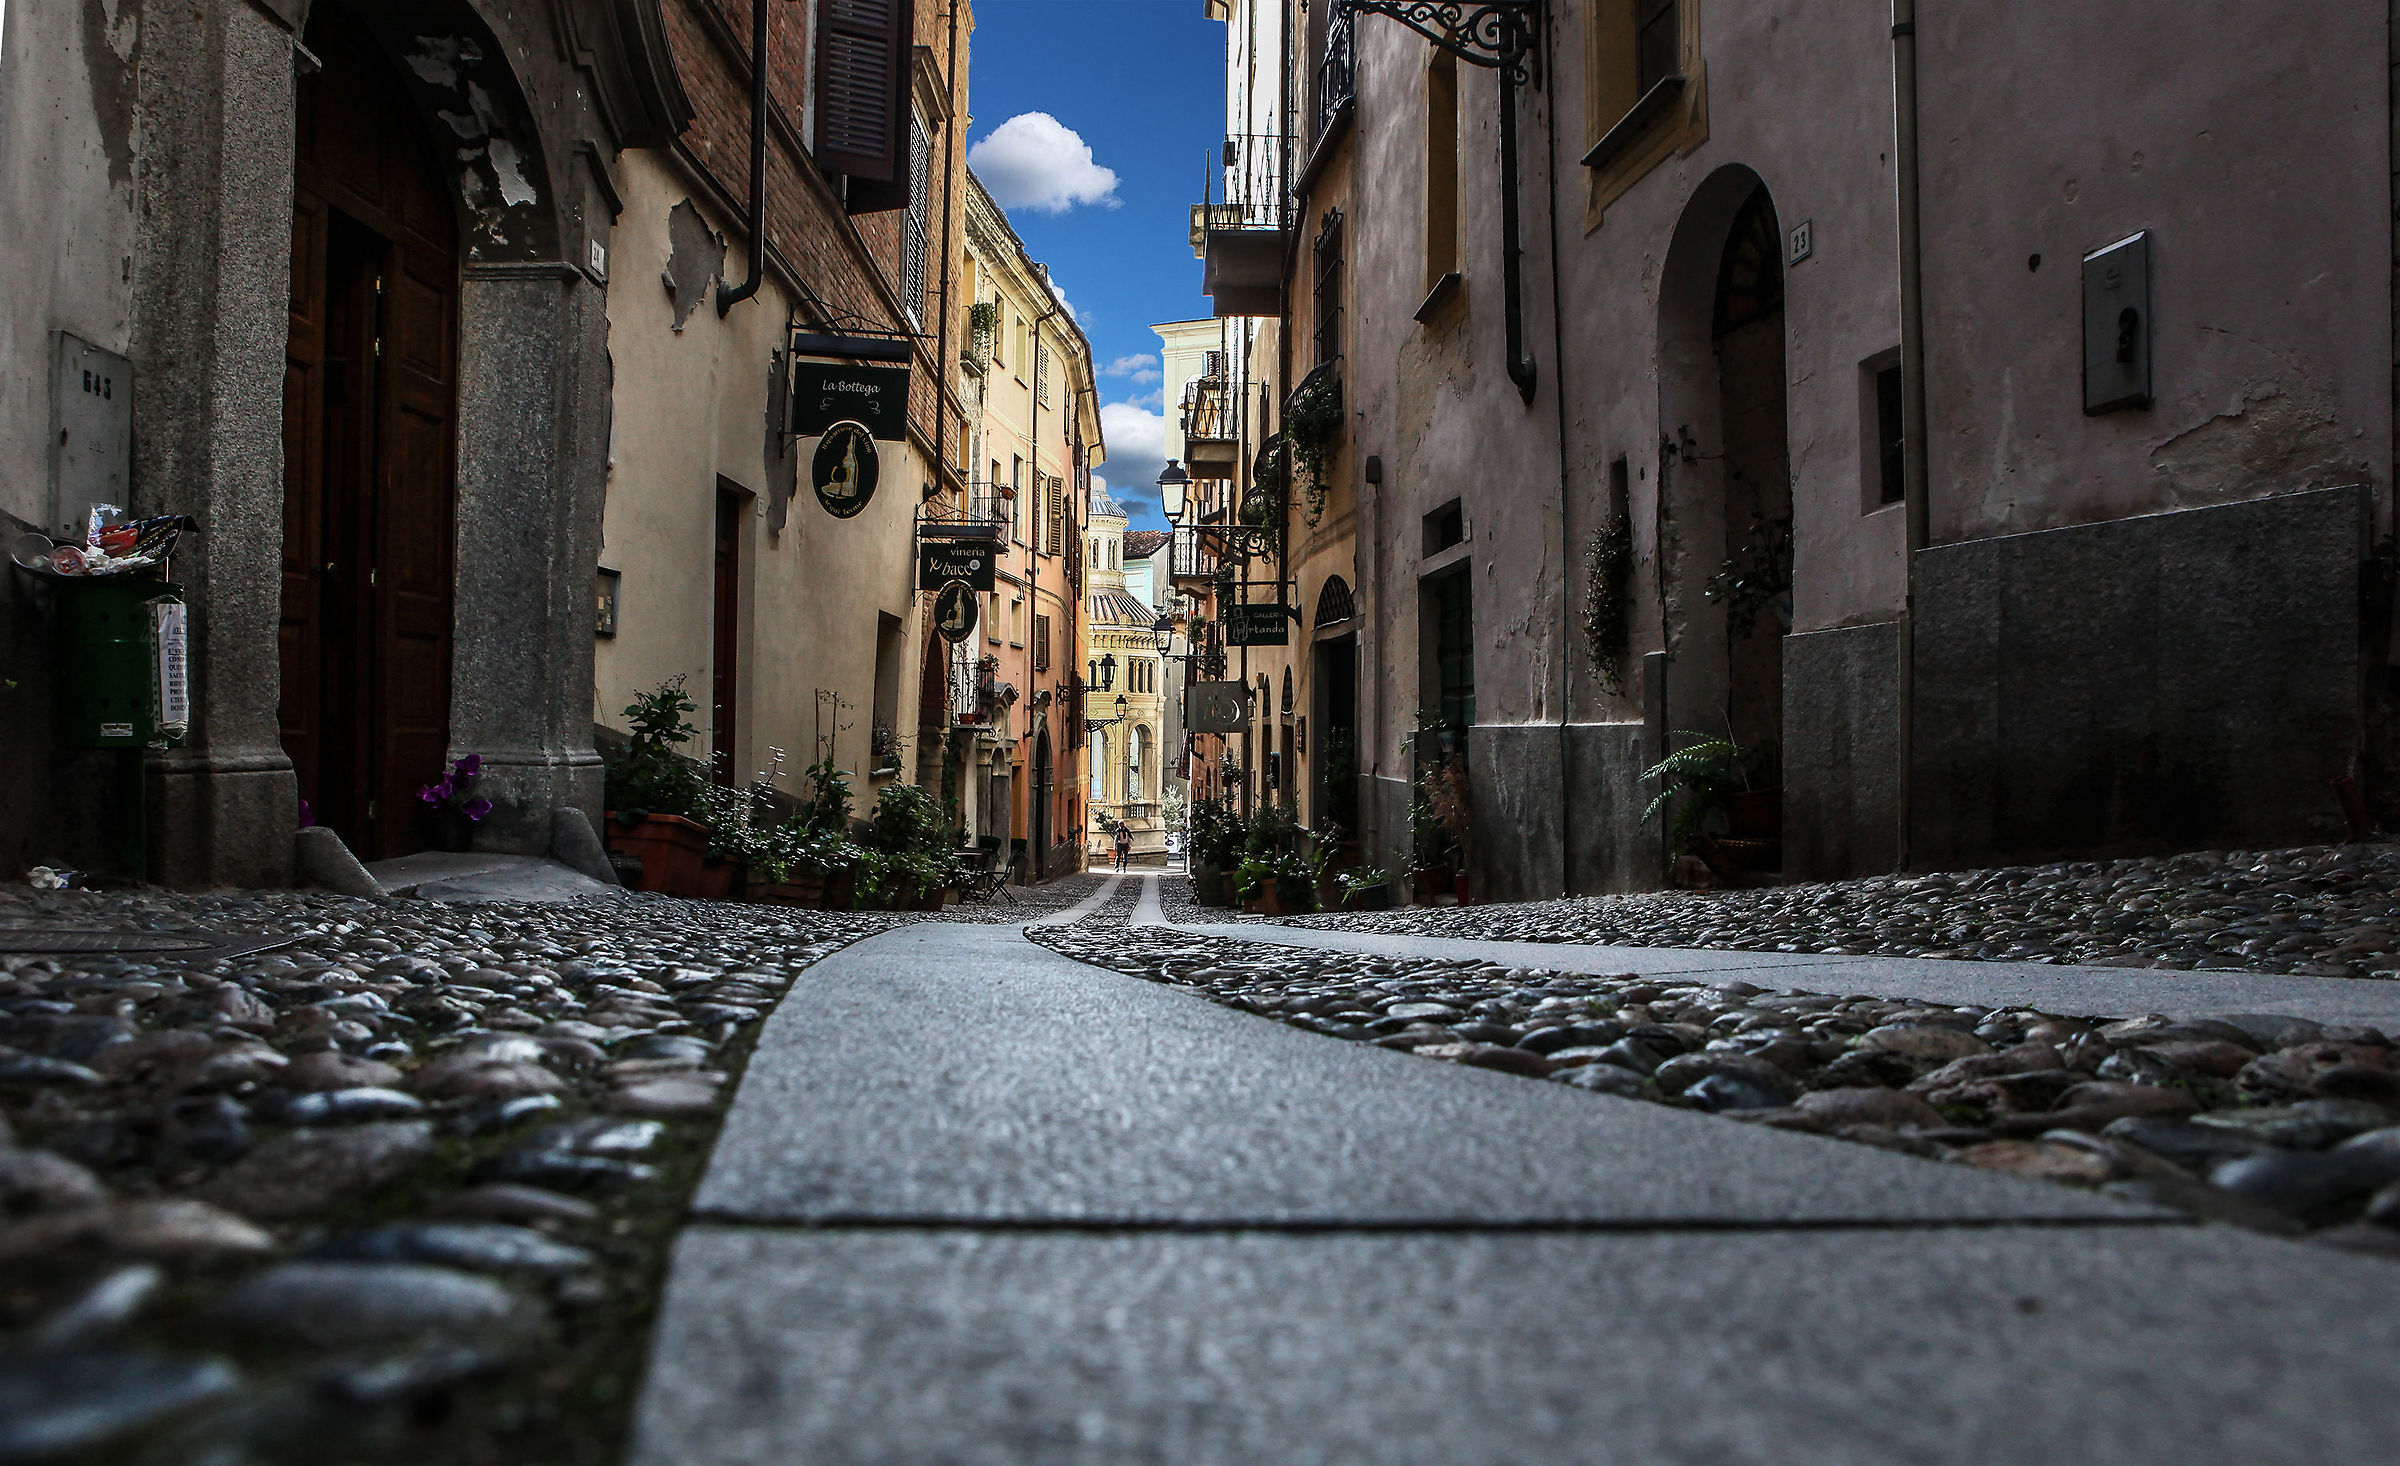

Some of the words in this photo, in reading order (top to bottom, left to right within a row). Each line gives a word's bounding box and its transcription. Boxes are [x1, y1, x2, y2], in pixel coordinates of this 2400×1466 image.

[1793, 231, 1806, 254] 23
[822, 380, 837, 391] La
[838, 381, 881, 396] Bottega
[950, 547, 986, 557] vineria
